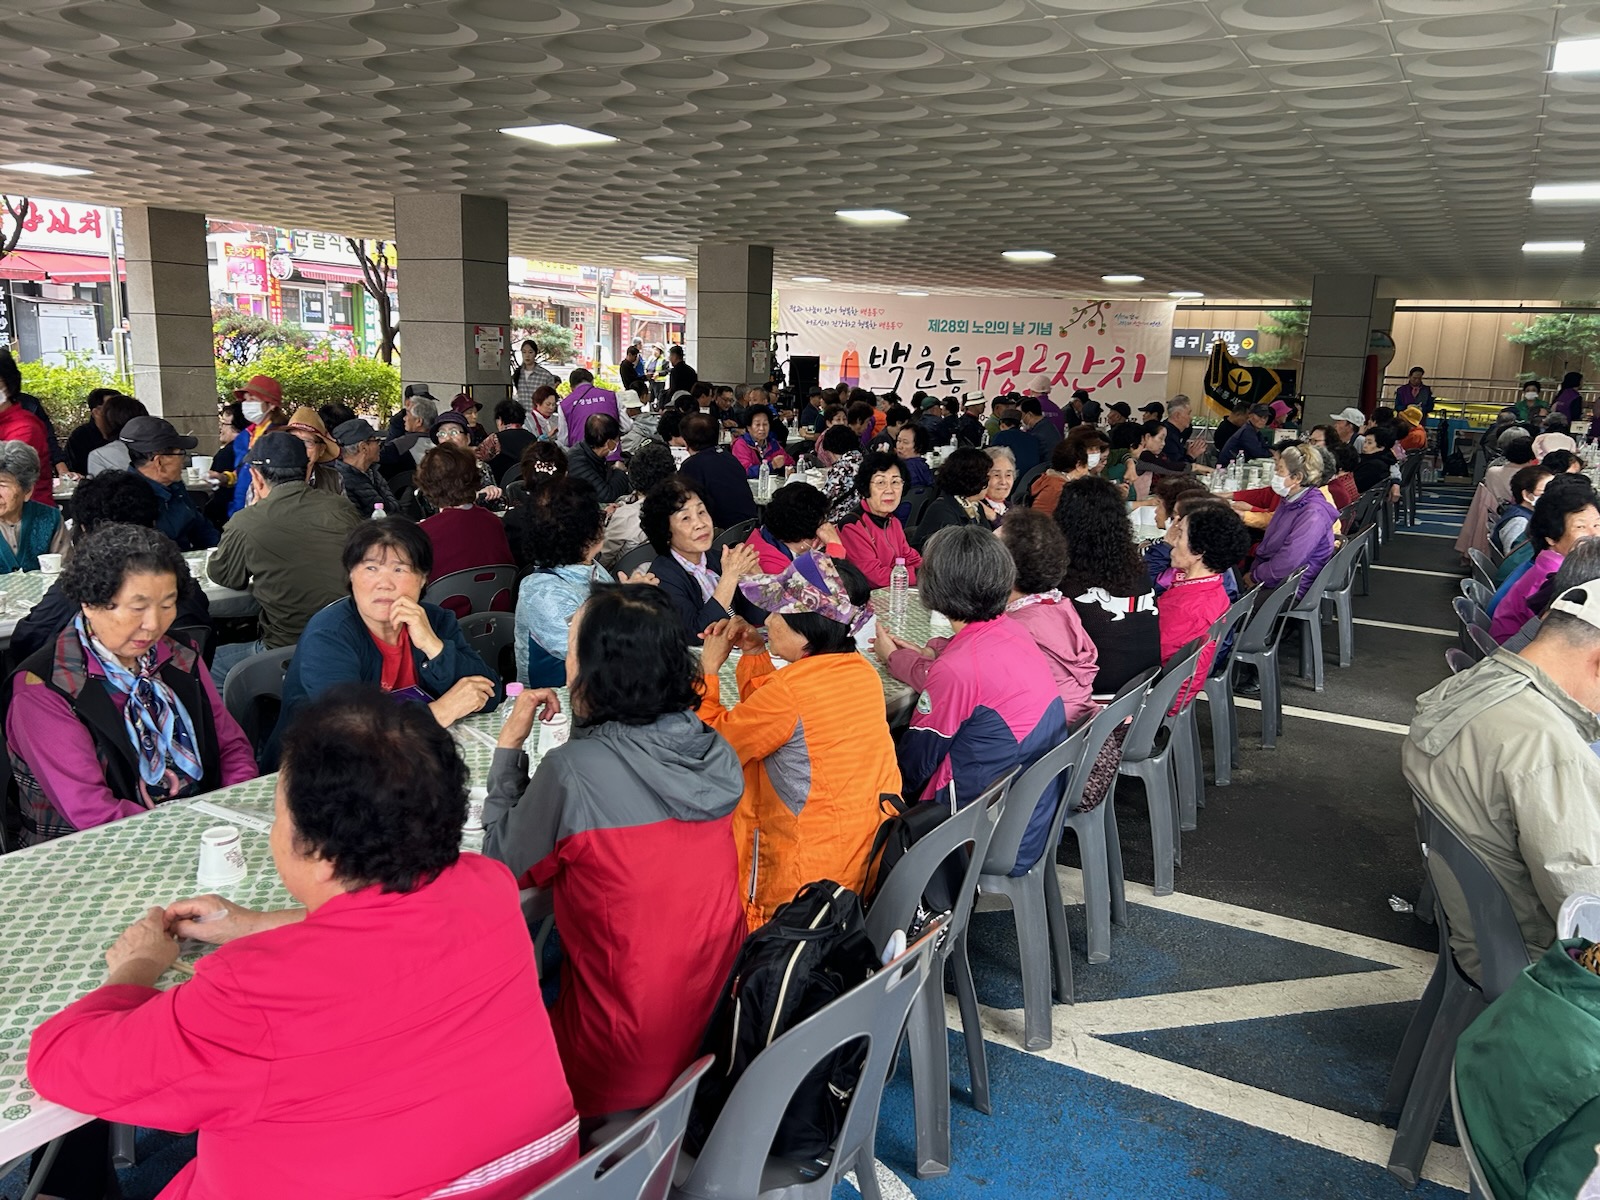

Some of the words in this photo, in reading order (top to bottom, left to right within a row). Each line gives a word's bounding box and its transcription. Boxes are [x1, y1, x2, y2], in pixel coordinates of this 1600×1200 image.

[824, 306, 837, 315] 있어
[839, 307, 858, 316] 행복한
[806, 319, 829, 327] 어르신이
[832, 320, 856, 328] 건강하고
[858, 320, 877, 330] 행복한
[927, 318, 969, 334] 제28회
[971, 319, 1009, 335] 노인의
[1012, 320, 1026, 336] 날
[1027, 321, 1053, 336] 기념
[1174, 336, 1200, 349] 출구
[1211, 331, 1237, 343] 지하
[1205, 343, 1240, 356] 주장
[869, 341, 969, 394] 백운동
[976, 343, 1147, 396] 경로잔치
